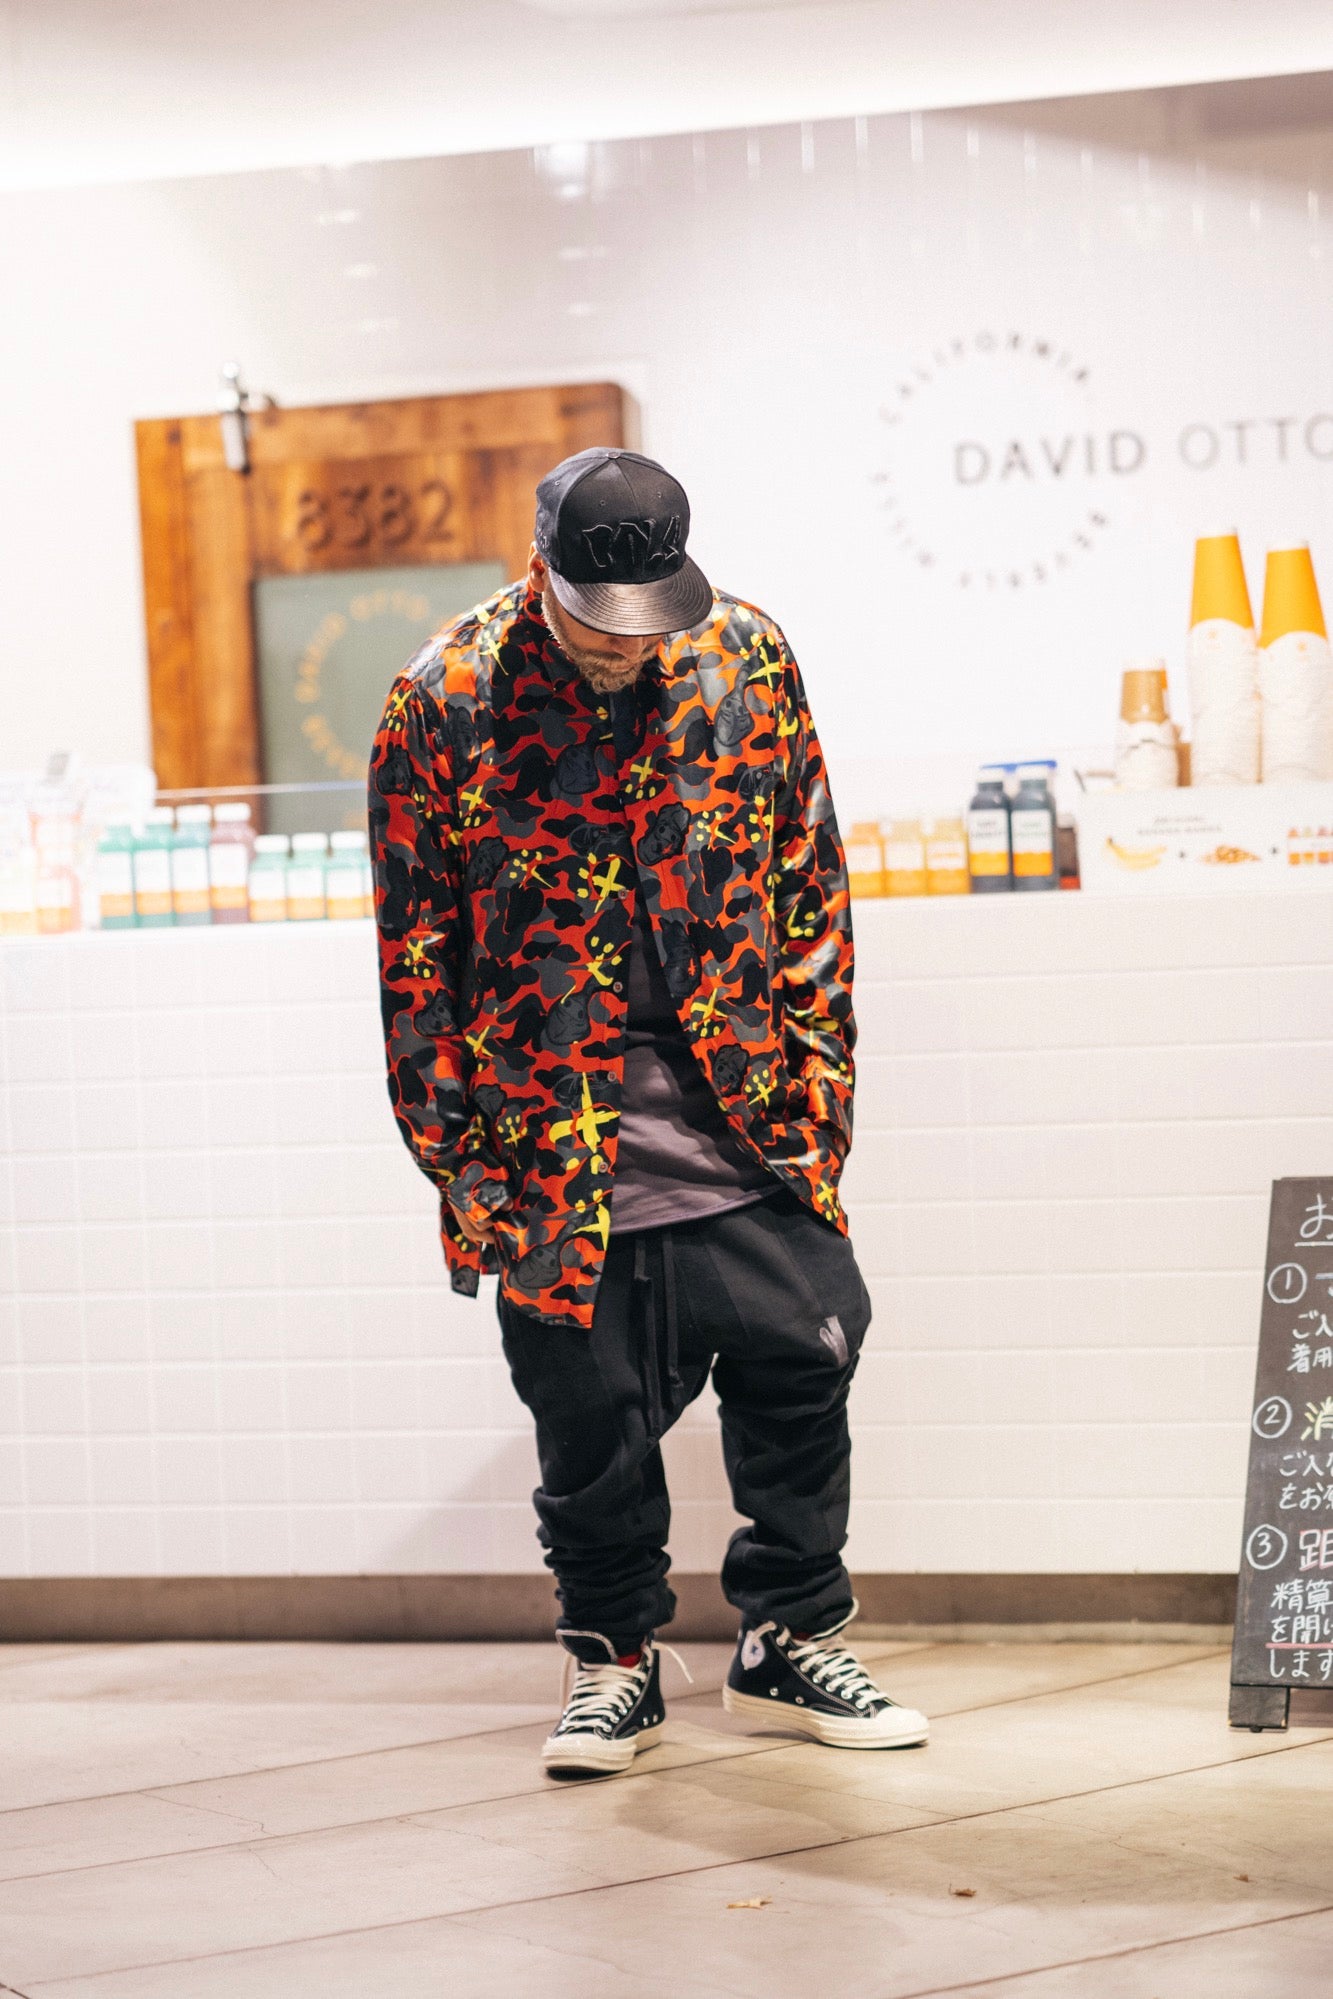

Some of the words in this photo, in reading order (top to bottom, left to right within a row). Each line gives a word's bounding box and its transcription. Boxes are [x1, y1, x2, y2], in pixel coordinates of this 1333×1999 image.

[954, 429, 1147, 486] DAVID
[1177, 413, 1333, 473] OTTO
[297, 479, 455, 551] 8382
